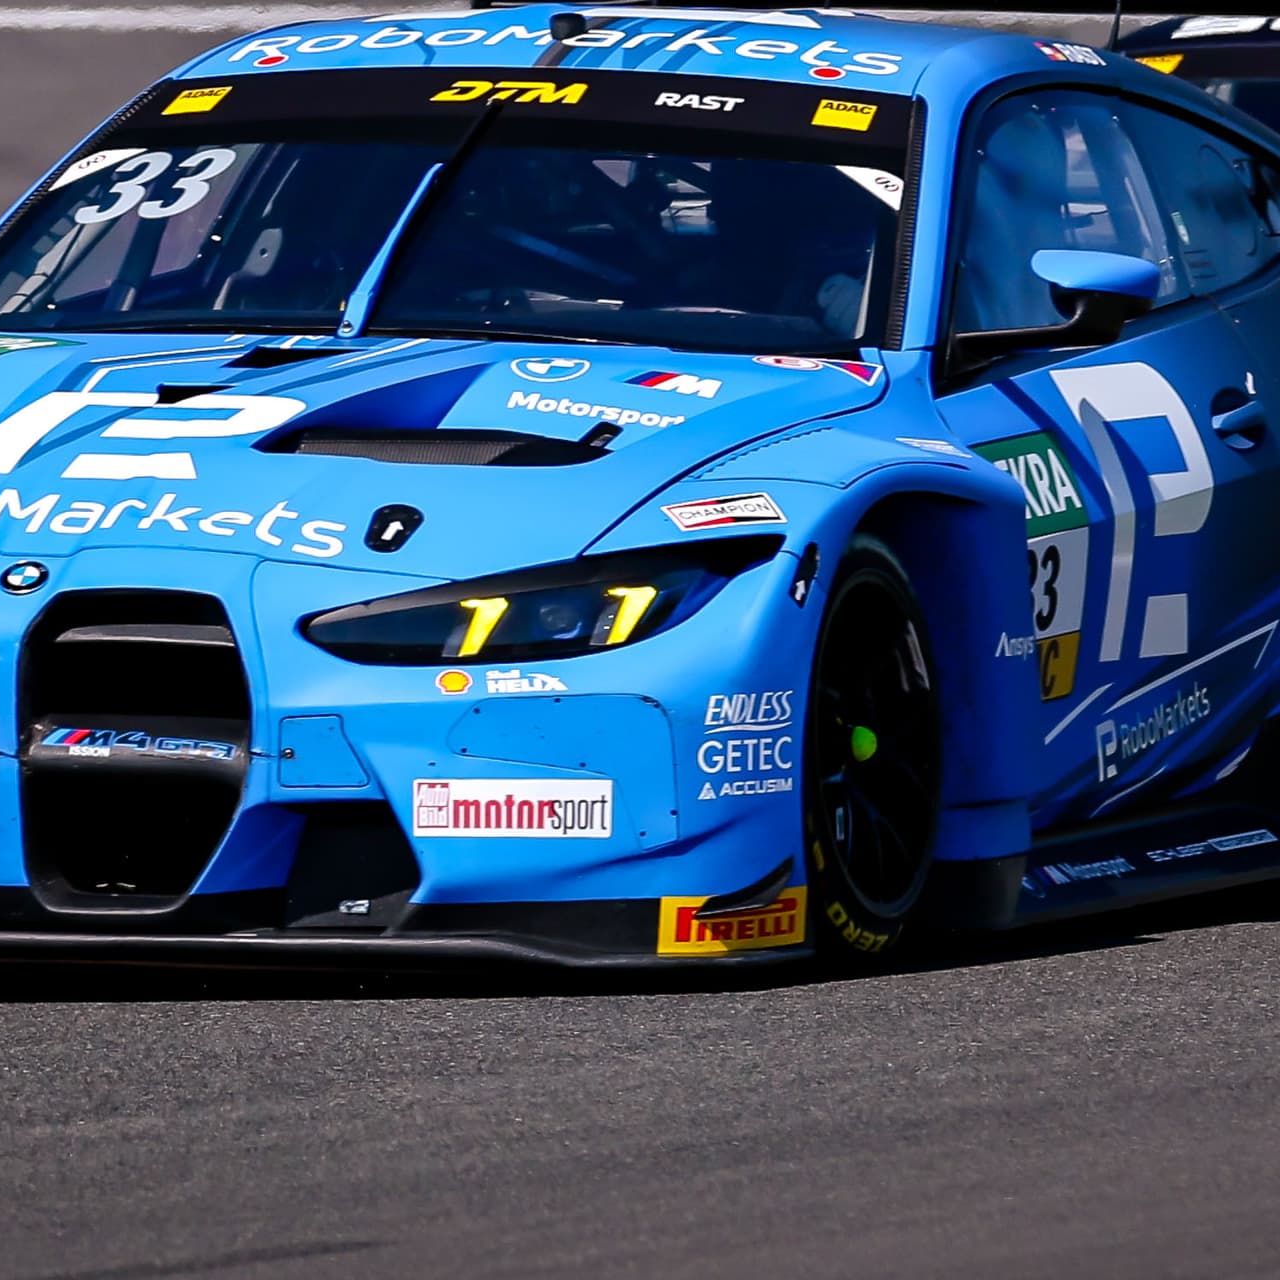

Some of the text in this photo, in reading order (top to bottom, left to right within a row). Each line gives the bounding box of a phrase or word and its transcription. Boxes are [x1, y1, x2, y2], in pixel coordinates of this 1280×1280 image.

[228, 22, 904, 77] RoboMarkets
[430, 81, 588, 104] DTM
[655, 92, 745, 112] RAST
[822, 100, 872, 115] ADAC
[74, 148, 237, 224] 33
[506, 390, 686, 427] Motorsport
[679, 502, 771, 520] CHAMPION
[486, 673, 569, 694] HELIX
[704, 690, 793, 727] ENDLESS
[1120, 682, 1211, 759] RoboMarkets
[154, 736, 237, 761] GT3
[697, 736, 793, 774] GETEC
[719, 777, 793, 797] ACCUSIM
[674, 896, 798, 943] PIRELLI
[826, 900, 889, 953] ZERO
